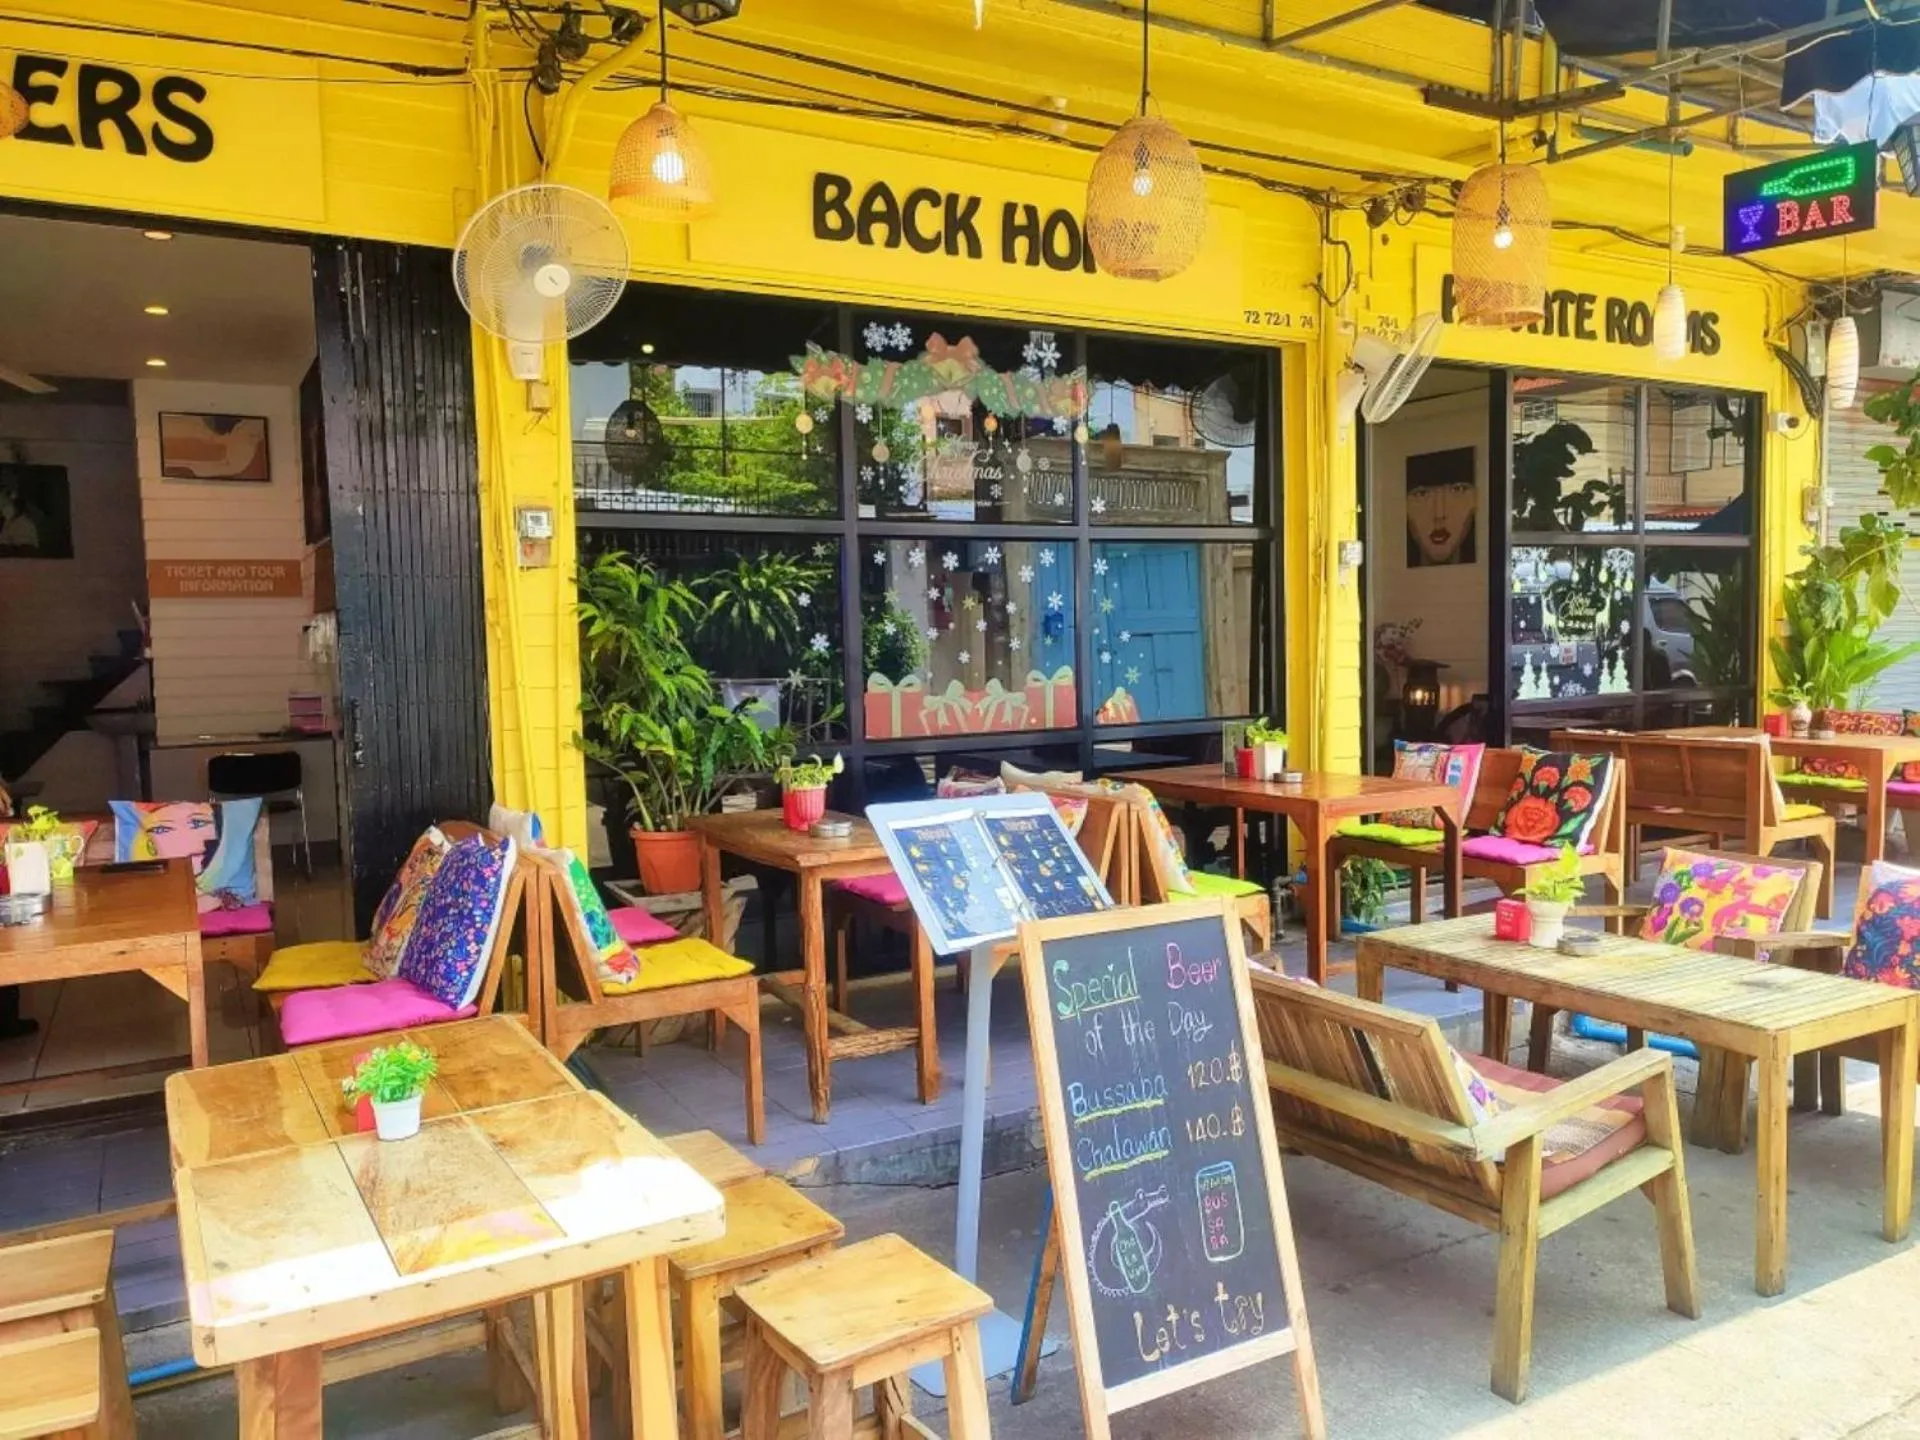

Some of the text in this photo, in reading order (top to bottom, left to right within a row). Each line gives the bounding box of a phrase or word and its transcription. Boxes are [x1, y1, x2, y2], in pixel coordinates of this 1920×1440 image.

[813, 172, 1156, 274] BACK HO
[1776, 195, 1854, 236] BAR
[1243, 311, 1260, 324] 72
[1605, 297, 1720, 356] ROMS
[165, 565, 286, 578] TICKET AND TOUR
[180, 580, 274, 593] INFORMATION
[1053, 943, 1222, 1025] Special Beer
[1085, 1001, 1213, 1057] of the Day
[1067, 1072, 1168, 1117] Bussaba
[1077, 1122, 1173, 1171] Chalawan
[1133, 1303, 1205, 1361] Let's
